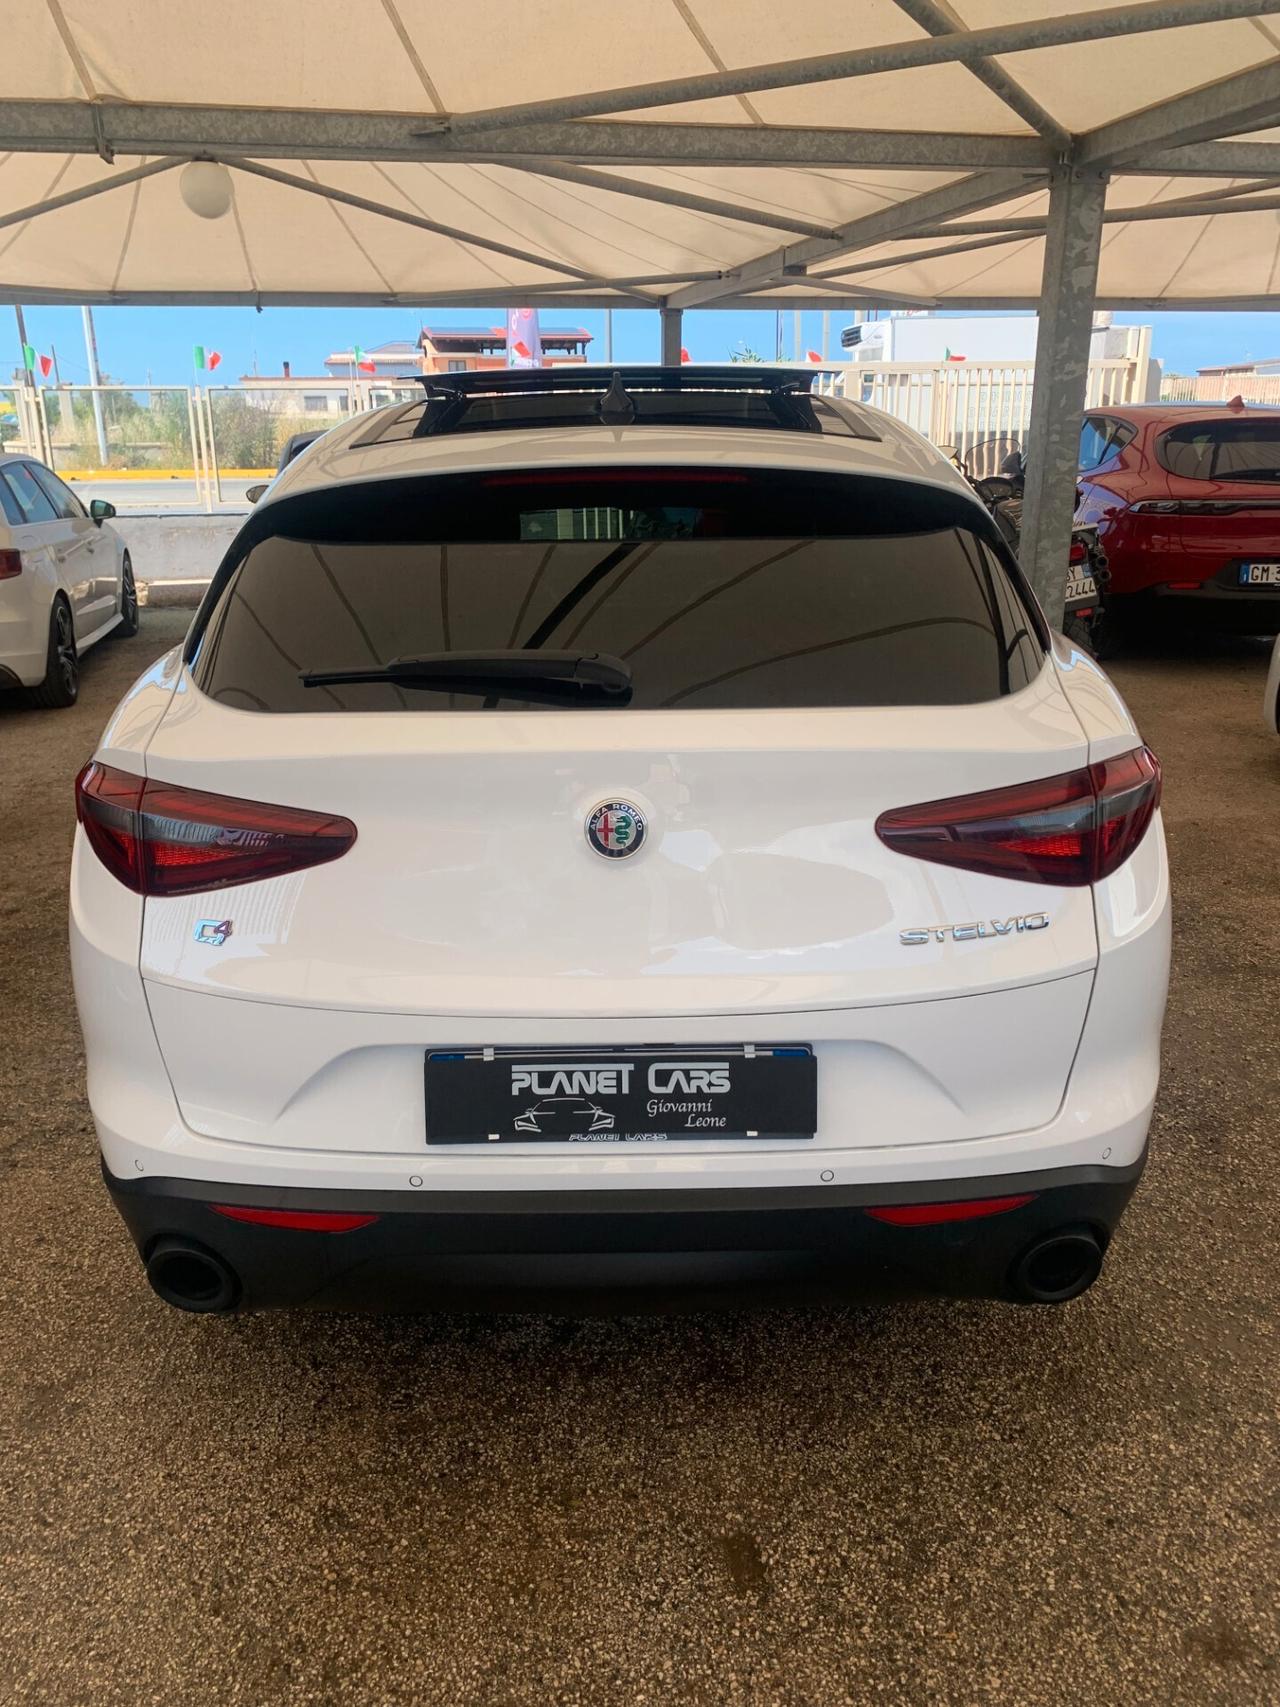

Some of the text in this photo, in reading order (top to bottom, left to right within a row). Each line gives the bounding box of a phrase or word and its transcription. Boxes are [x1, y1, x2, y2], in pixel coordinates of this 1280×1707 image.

[1251, 566, 1270, 581] GM
[1065, 580, 1095, 599] 2444
[590, 804, 642, 830] ALFA ROMEO
[899, 911, 1050, 945] STELVIO
[512, 1062, 731, 1096] PLANET CARS
[647, 1099, 712, 1117] Giovanni
[684, 1114, 726, 1128] Leone
